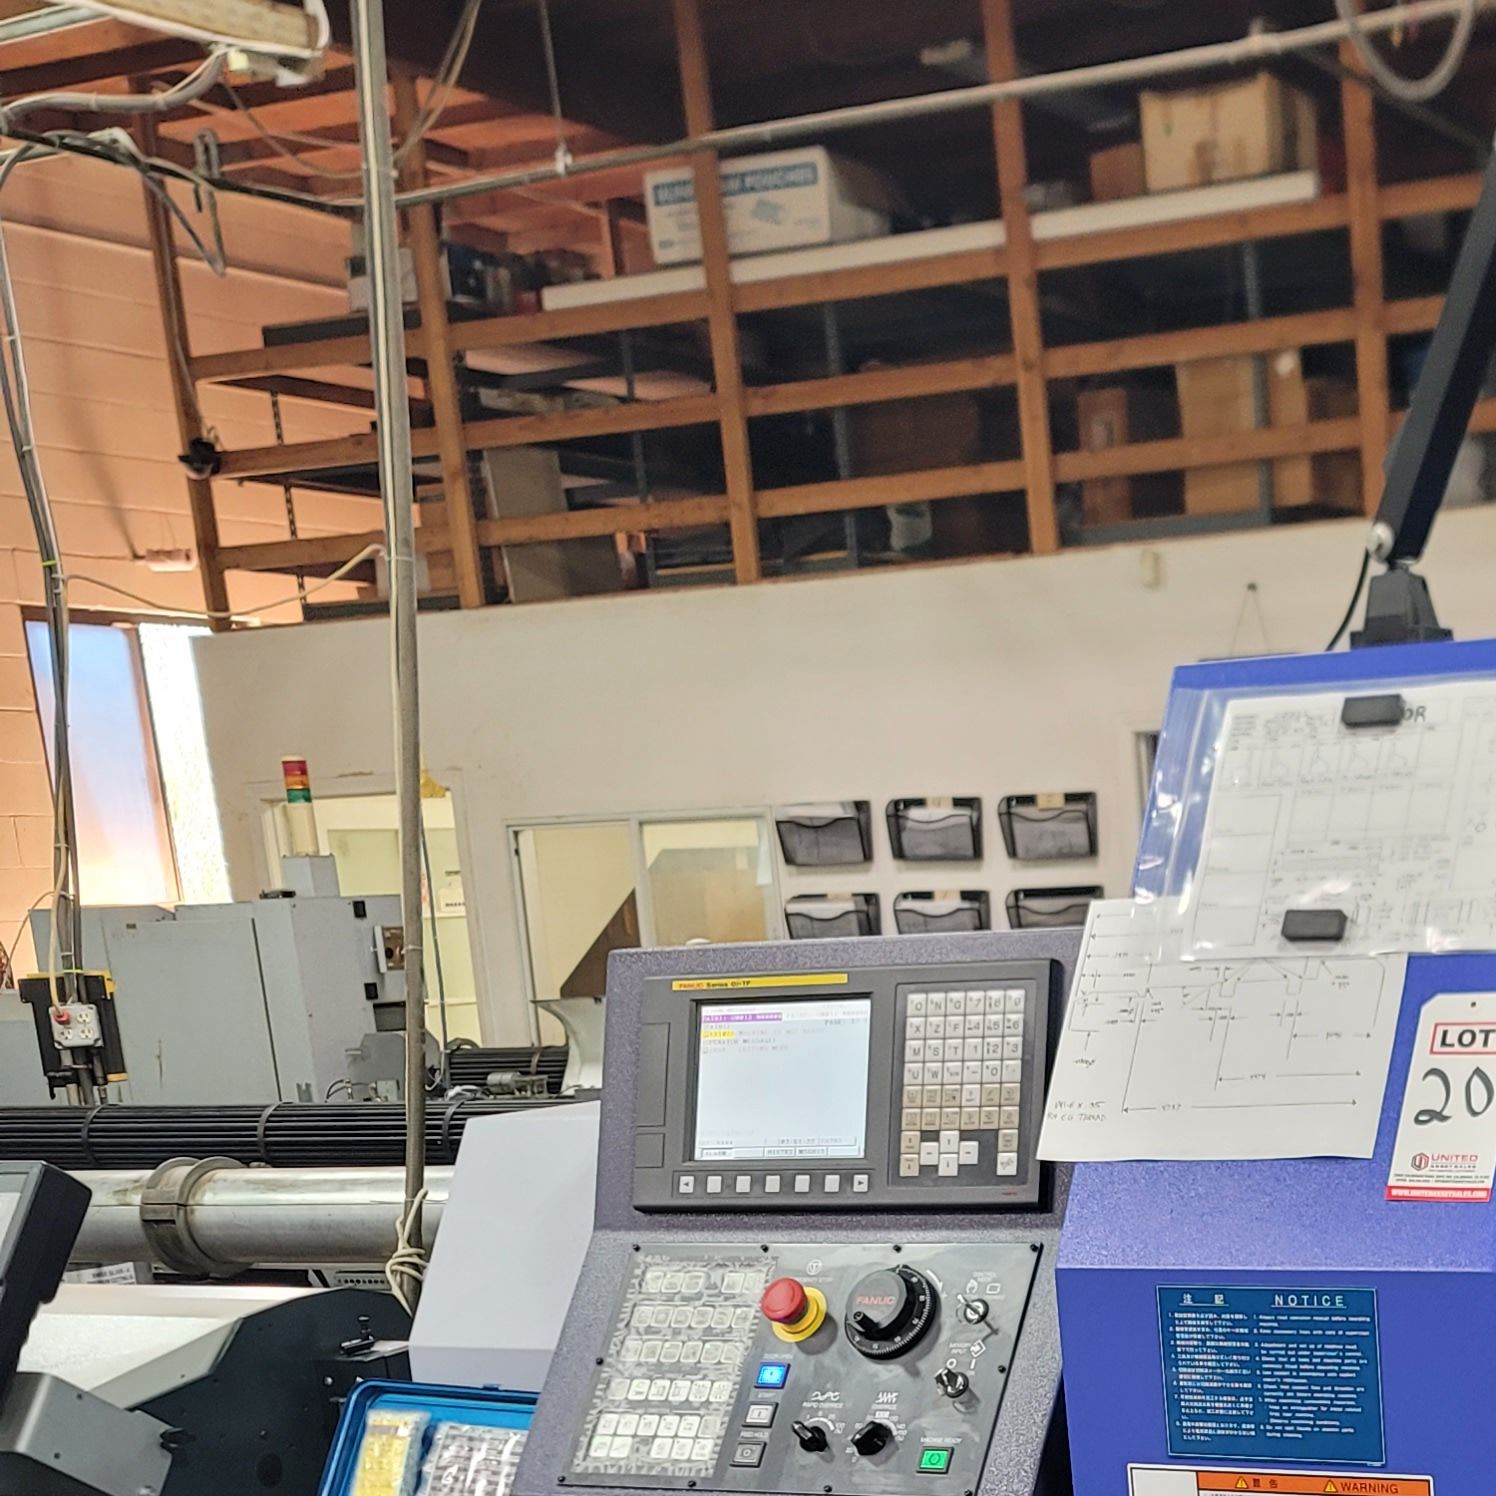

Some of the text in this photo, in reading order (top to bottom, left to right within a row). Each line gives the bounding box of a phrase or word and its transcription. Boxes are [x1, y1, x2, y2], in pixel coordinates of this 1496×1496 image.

[1440, 1029, 1496, 1048] LOT
[1414, 1066, 1495, 1126] 20
[1431, 1153, 1478, 1162] UNITED
[855, 1296, 896, 1306] FANUC
[1274, 1294, 1344, 1307] NOTICE
[1341, 1481, 1399, 1495] WARNING
